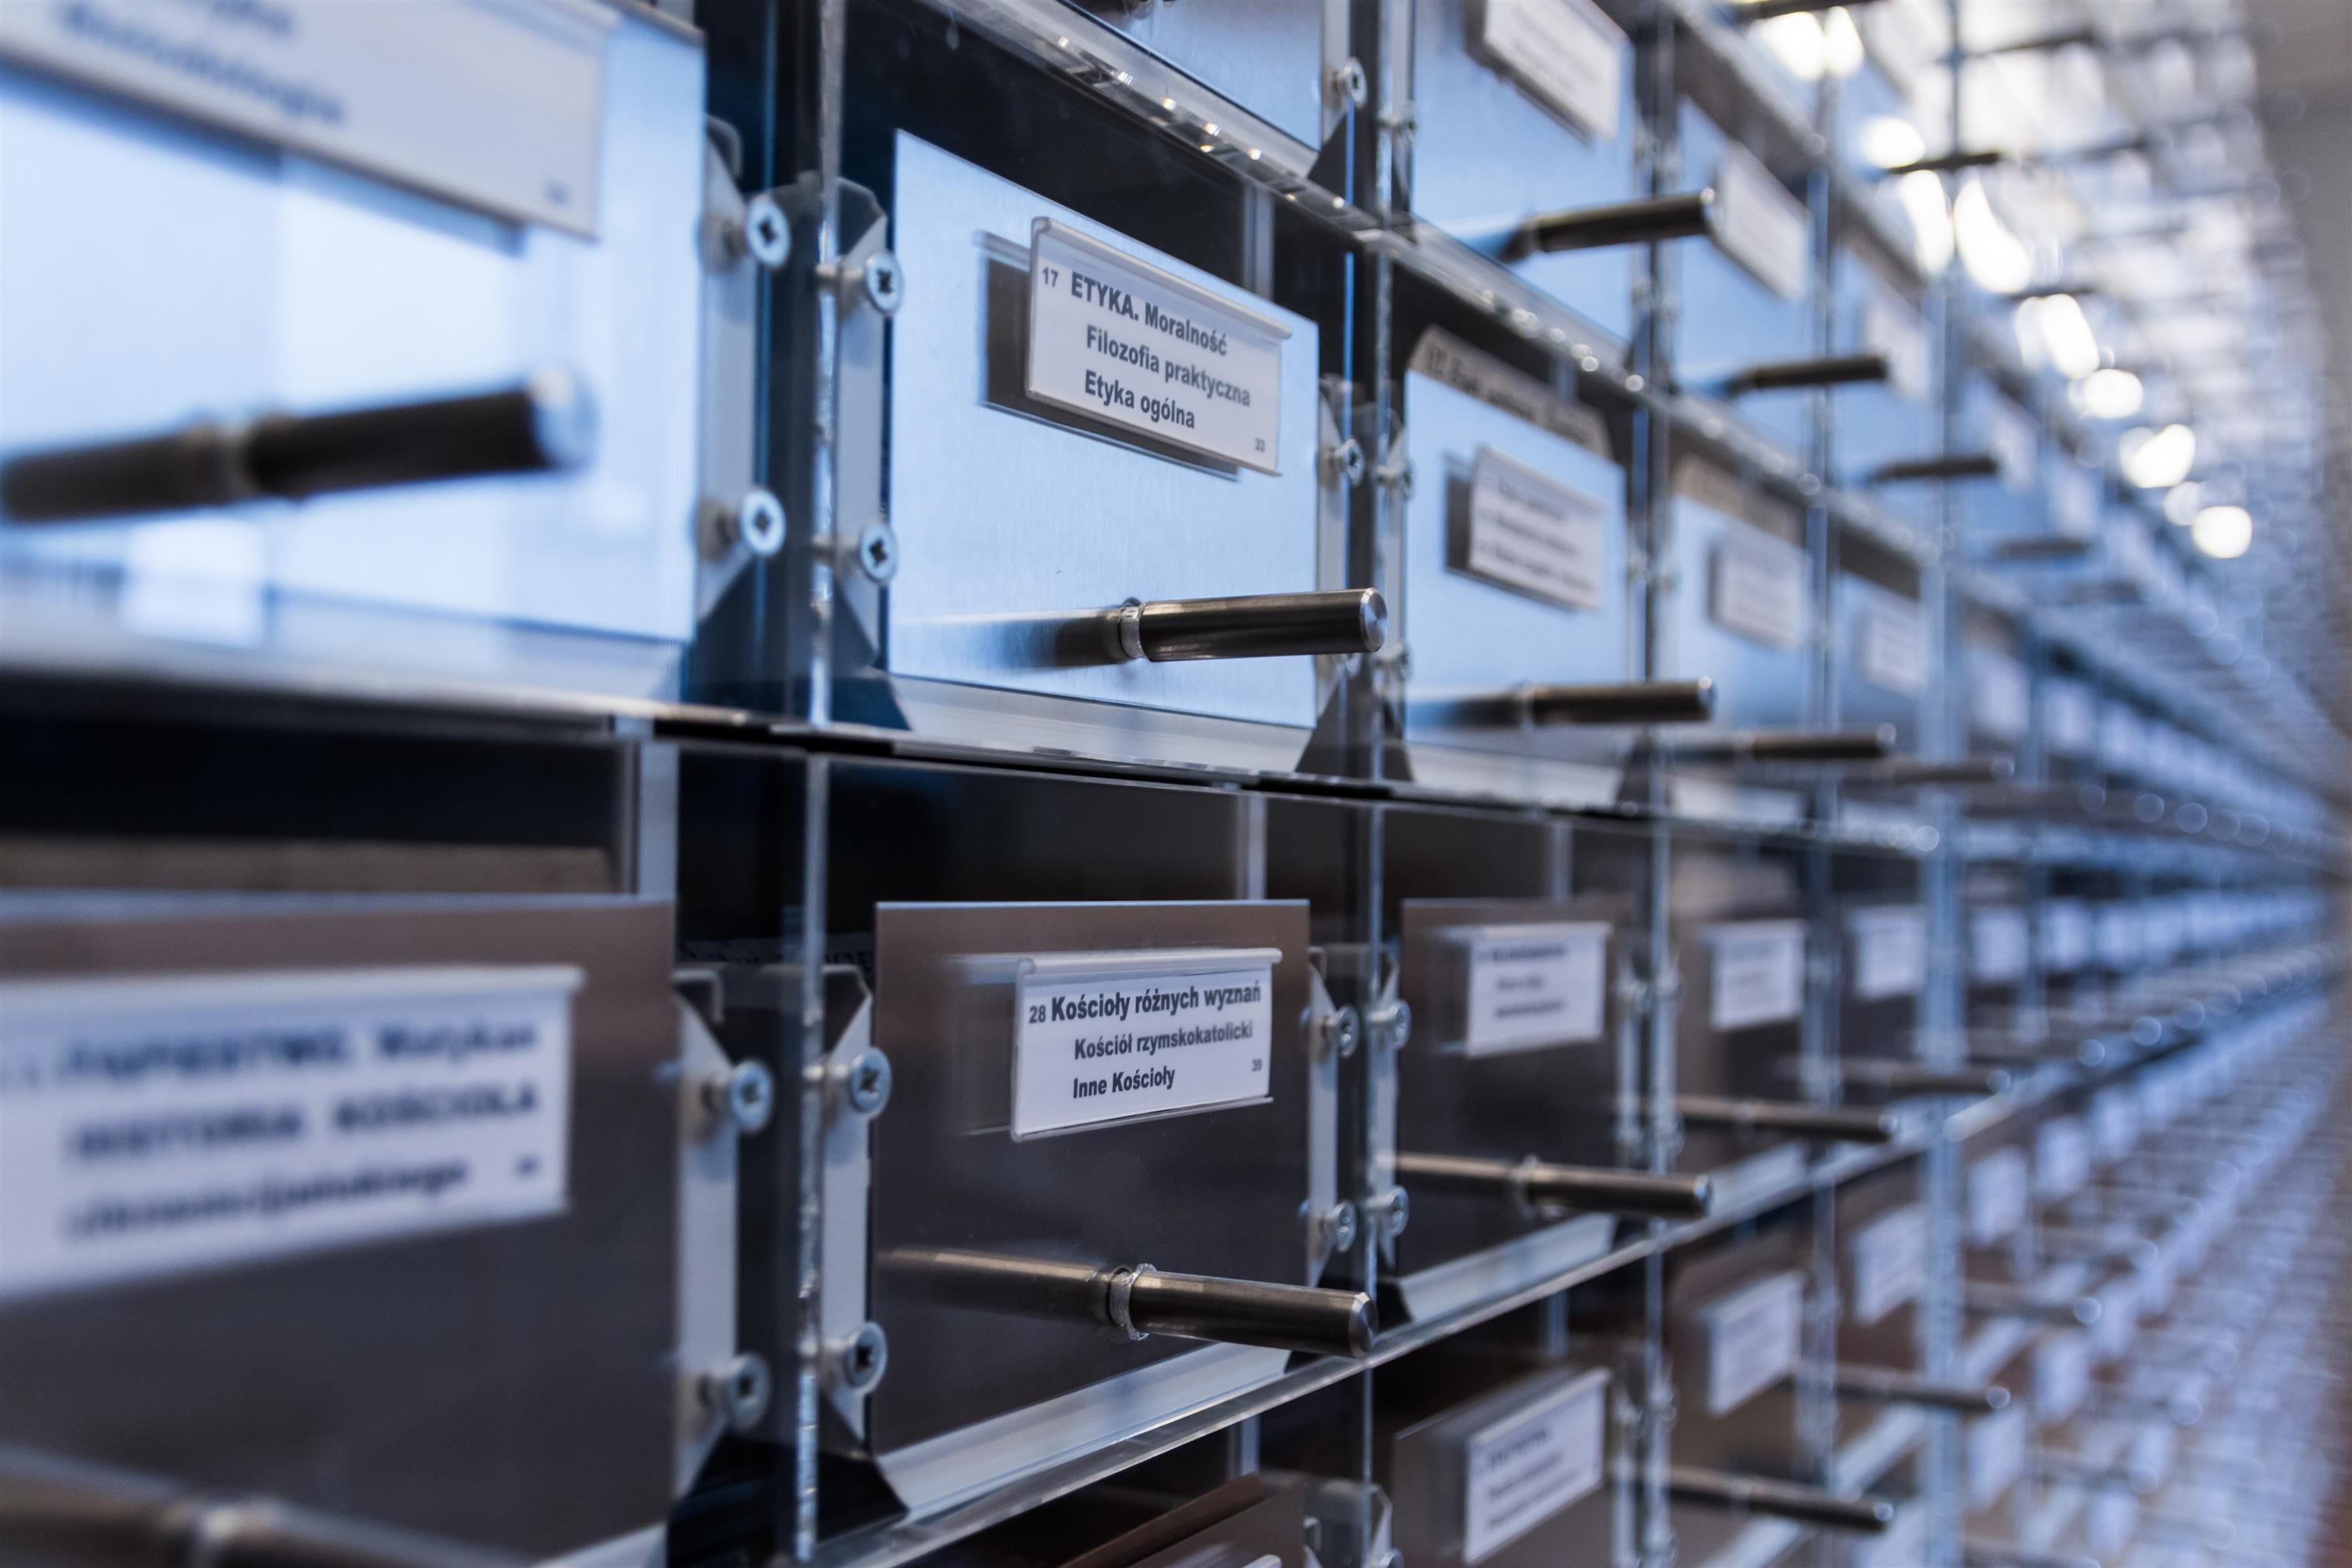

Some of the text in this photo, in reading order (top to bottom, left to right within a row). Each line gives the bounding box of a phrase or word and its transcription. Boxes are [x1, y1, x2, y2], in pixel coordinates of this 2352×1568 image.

[1042, 267, 1228, 357] 17 ETYKA. Moralność
[1087, 325, 1251, 407] Filozofia praktyczna
[1085, 369, 1196, 429] Etyka ogólna
[1029, 980, 1261, 1024] 28 Kościoły różnych wyznań
[1075, 1019, 1253, 1060] Kościół rzymskokatolicki
[1073, 1065, 1176, 1098] Inne Kościoły
